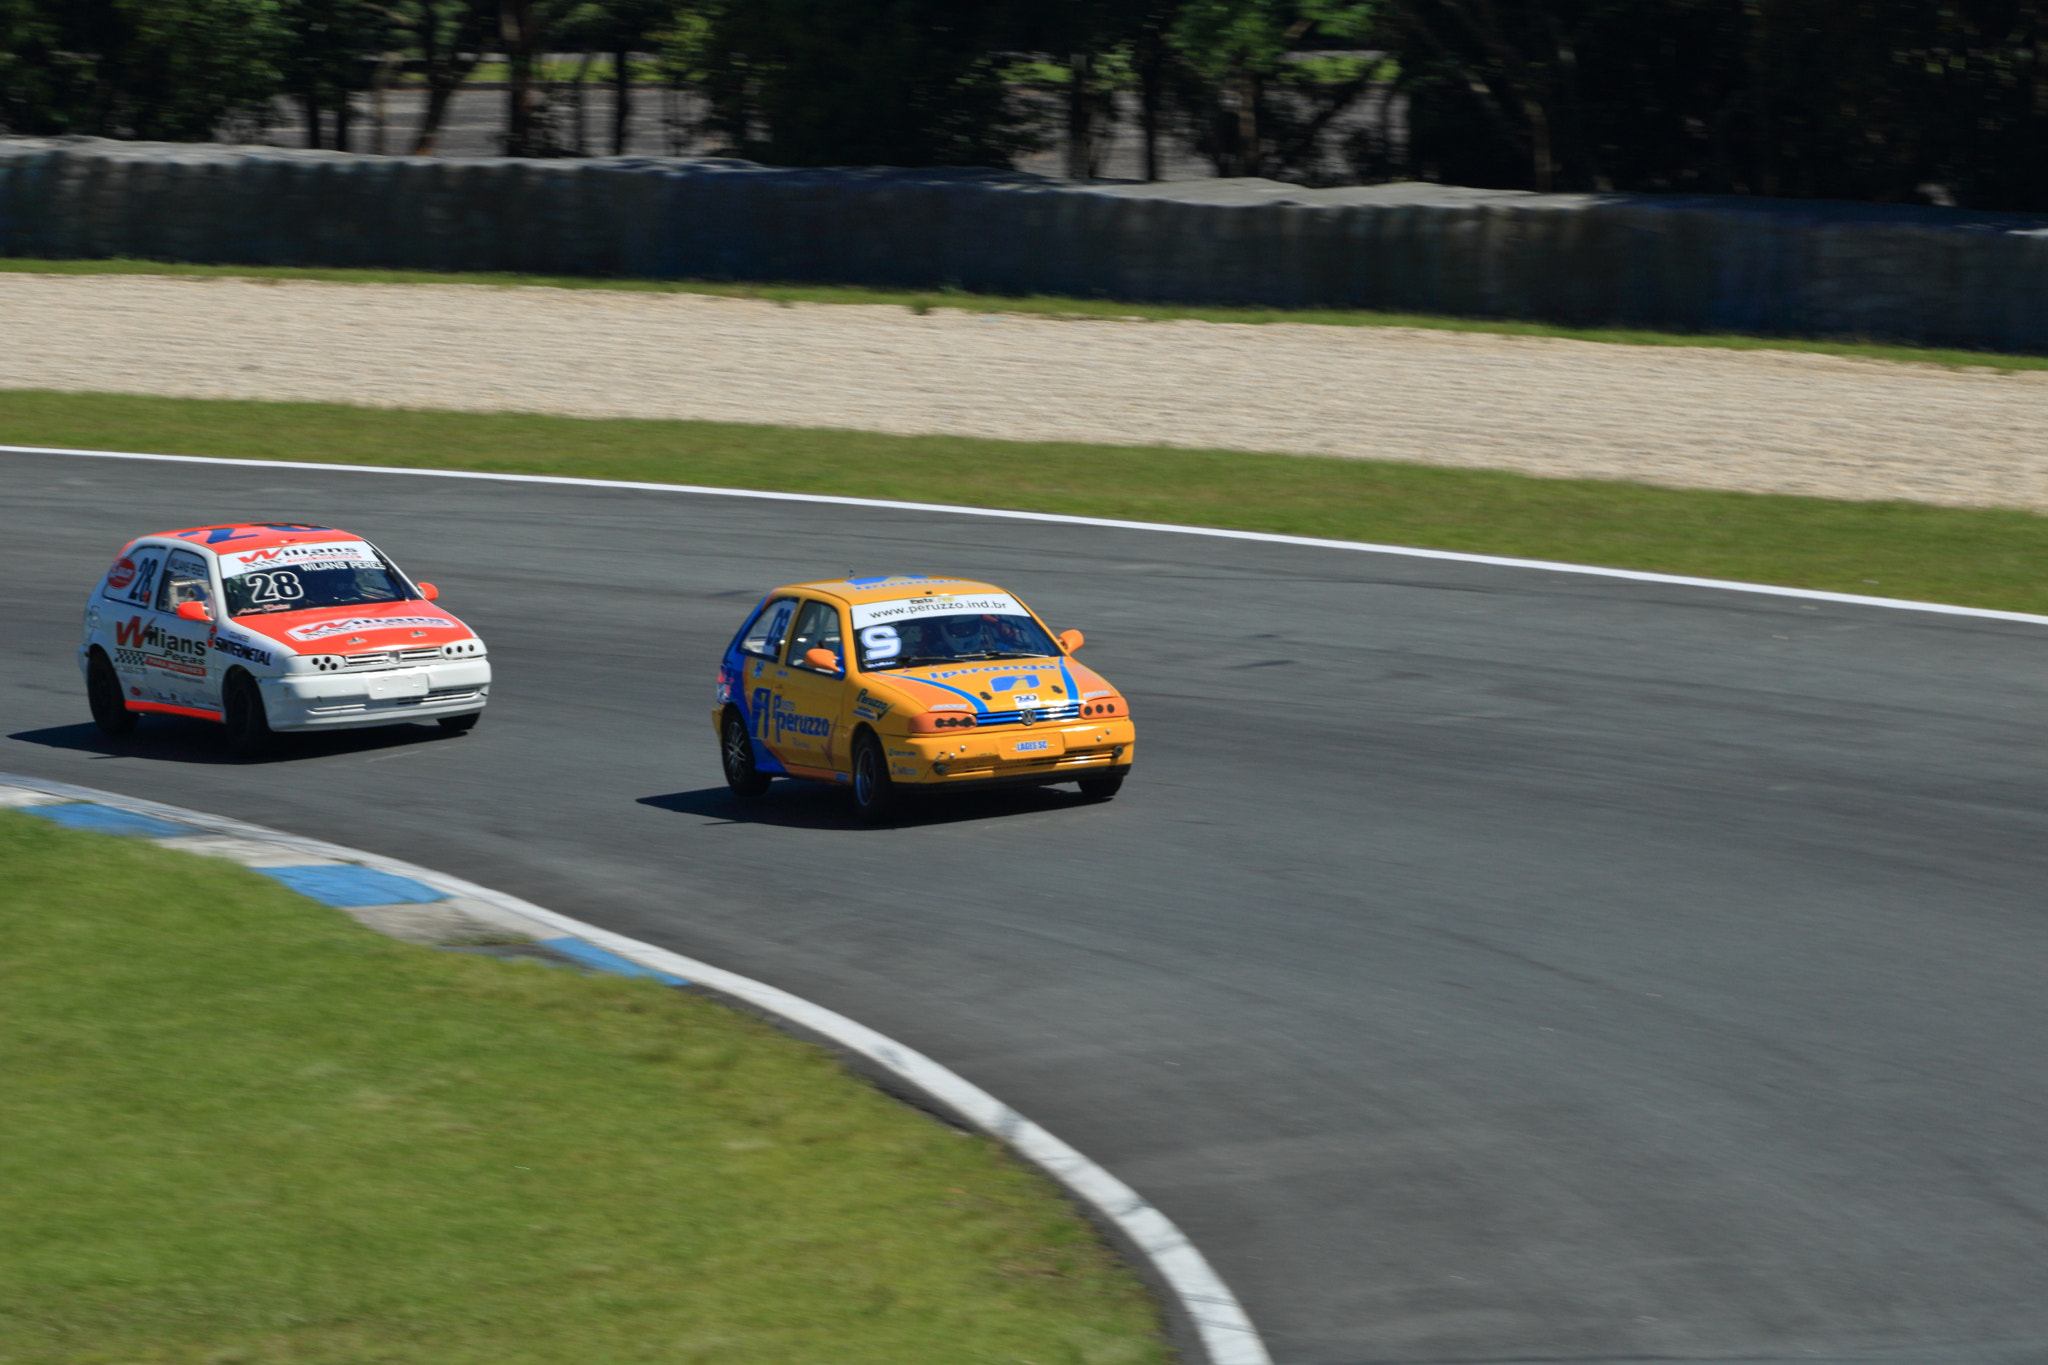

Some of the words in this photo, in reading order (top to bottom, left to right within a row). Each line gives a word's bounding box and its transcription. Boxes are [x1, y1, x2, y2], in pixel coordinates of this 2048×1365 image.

[237, 547, 359, 564] Wilians
[350, 560, 386, 570] PERES
[128, 557, 158, 602] 28
[246, 571, 304, 603] 28
[869, 600, 1008, 619] www.peruzzo.ind.br
[164, 649, 206, 666] Peças
[929, 664, 1058, 679] Ipiranga
[775, 710, 830, 744] peruzzo
[1016, 741, 1038, 752] LAGES
[1038, 740, 1048, 750] SC
